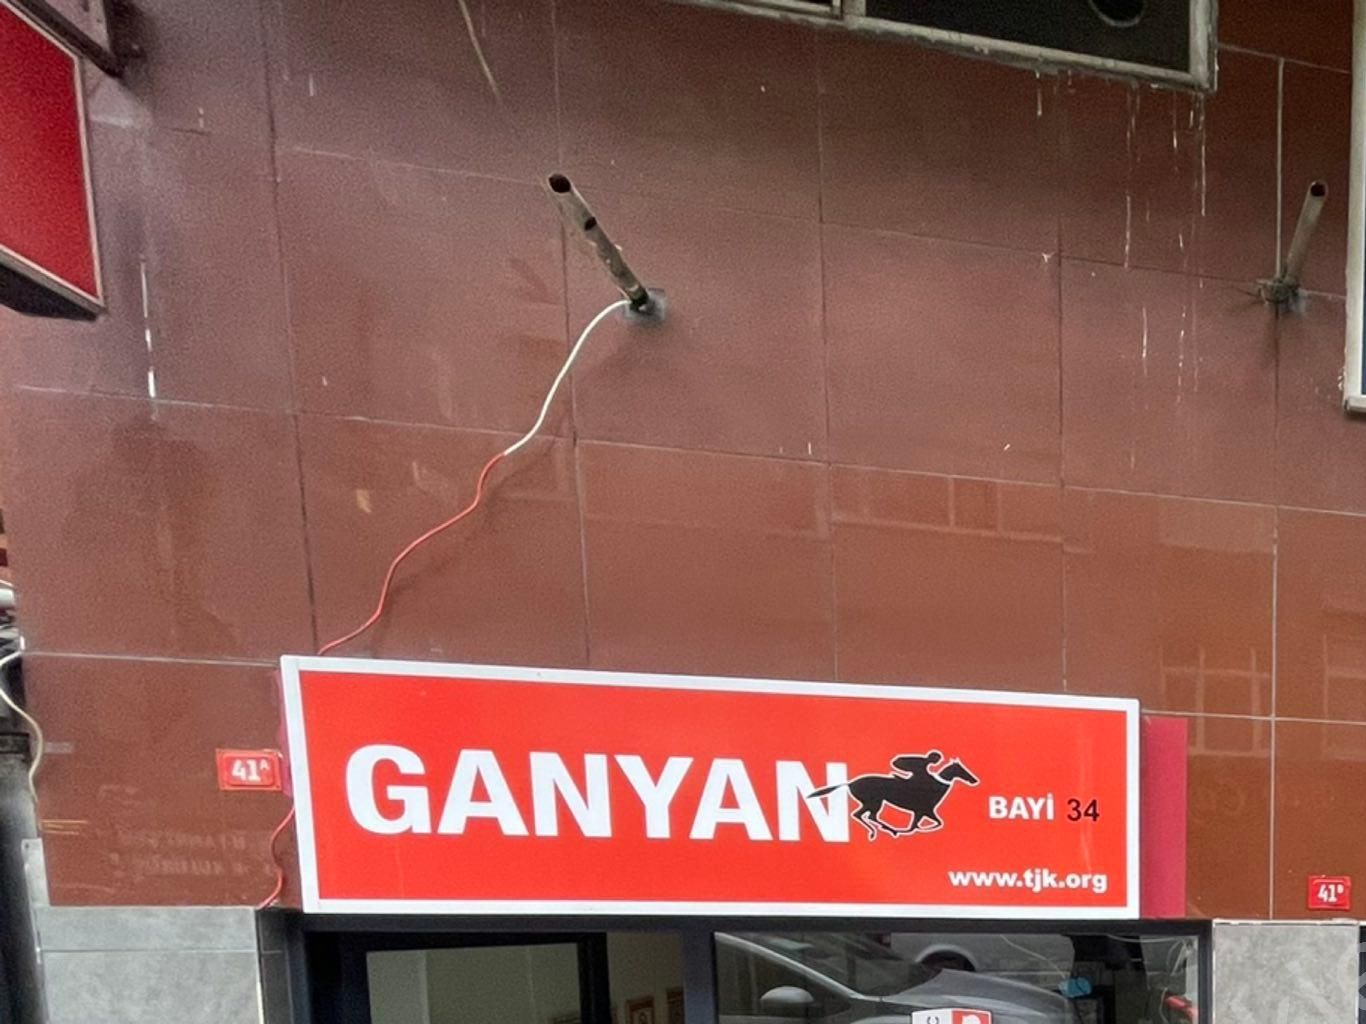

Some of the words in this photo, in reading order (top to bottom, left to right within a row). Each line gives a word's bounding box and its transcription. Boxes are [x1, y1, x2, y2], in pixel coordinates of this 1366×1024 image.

[343, 744, 850, 843] GANYAN
[988, 792, 1055, 820] BAYİ
[1066, 798, 1100, 822] 34
[947, 867, 1108, 894] www.tjk.org
